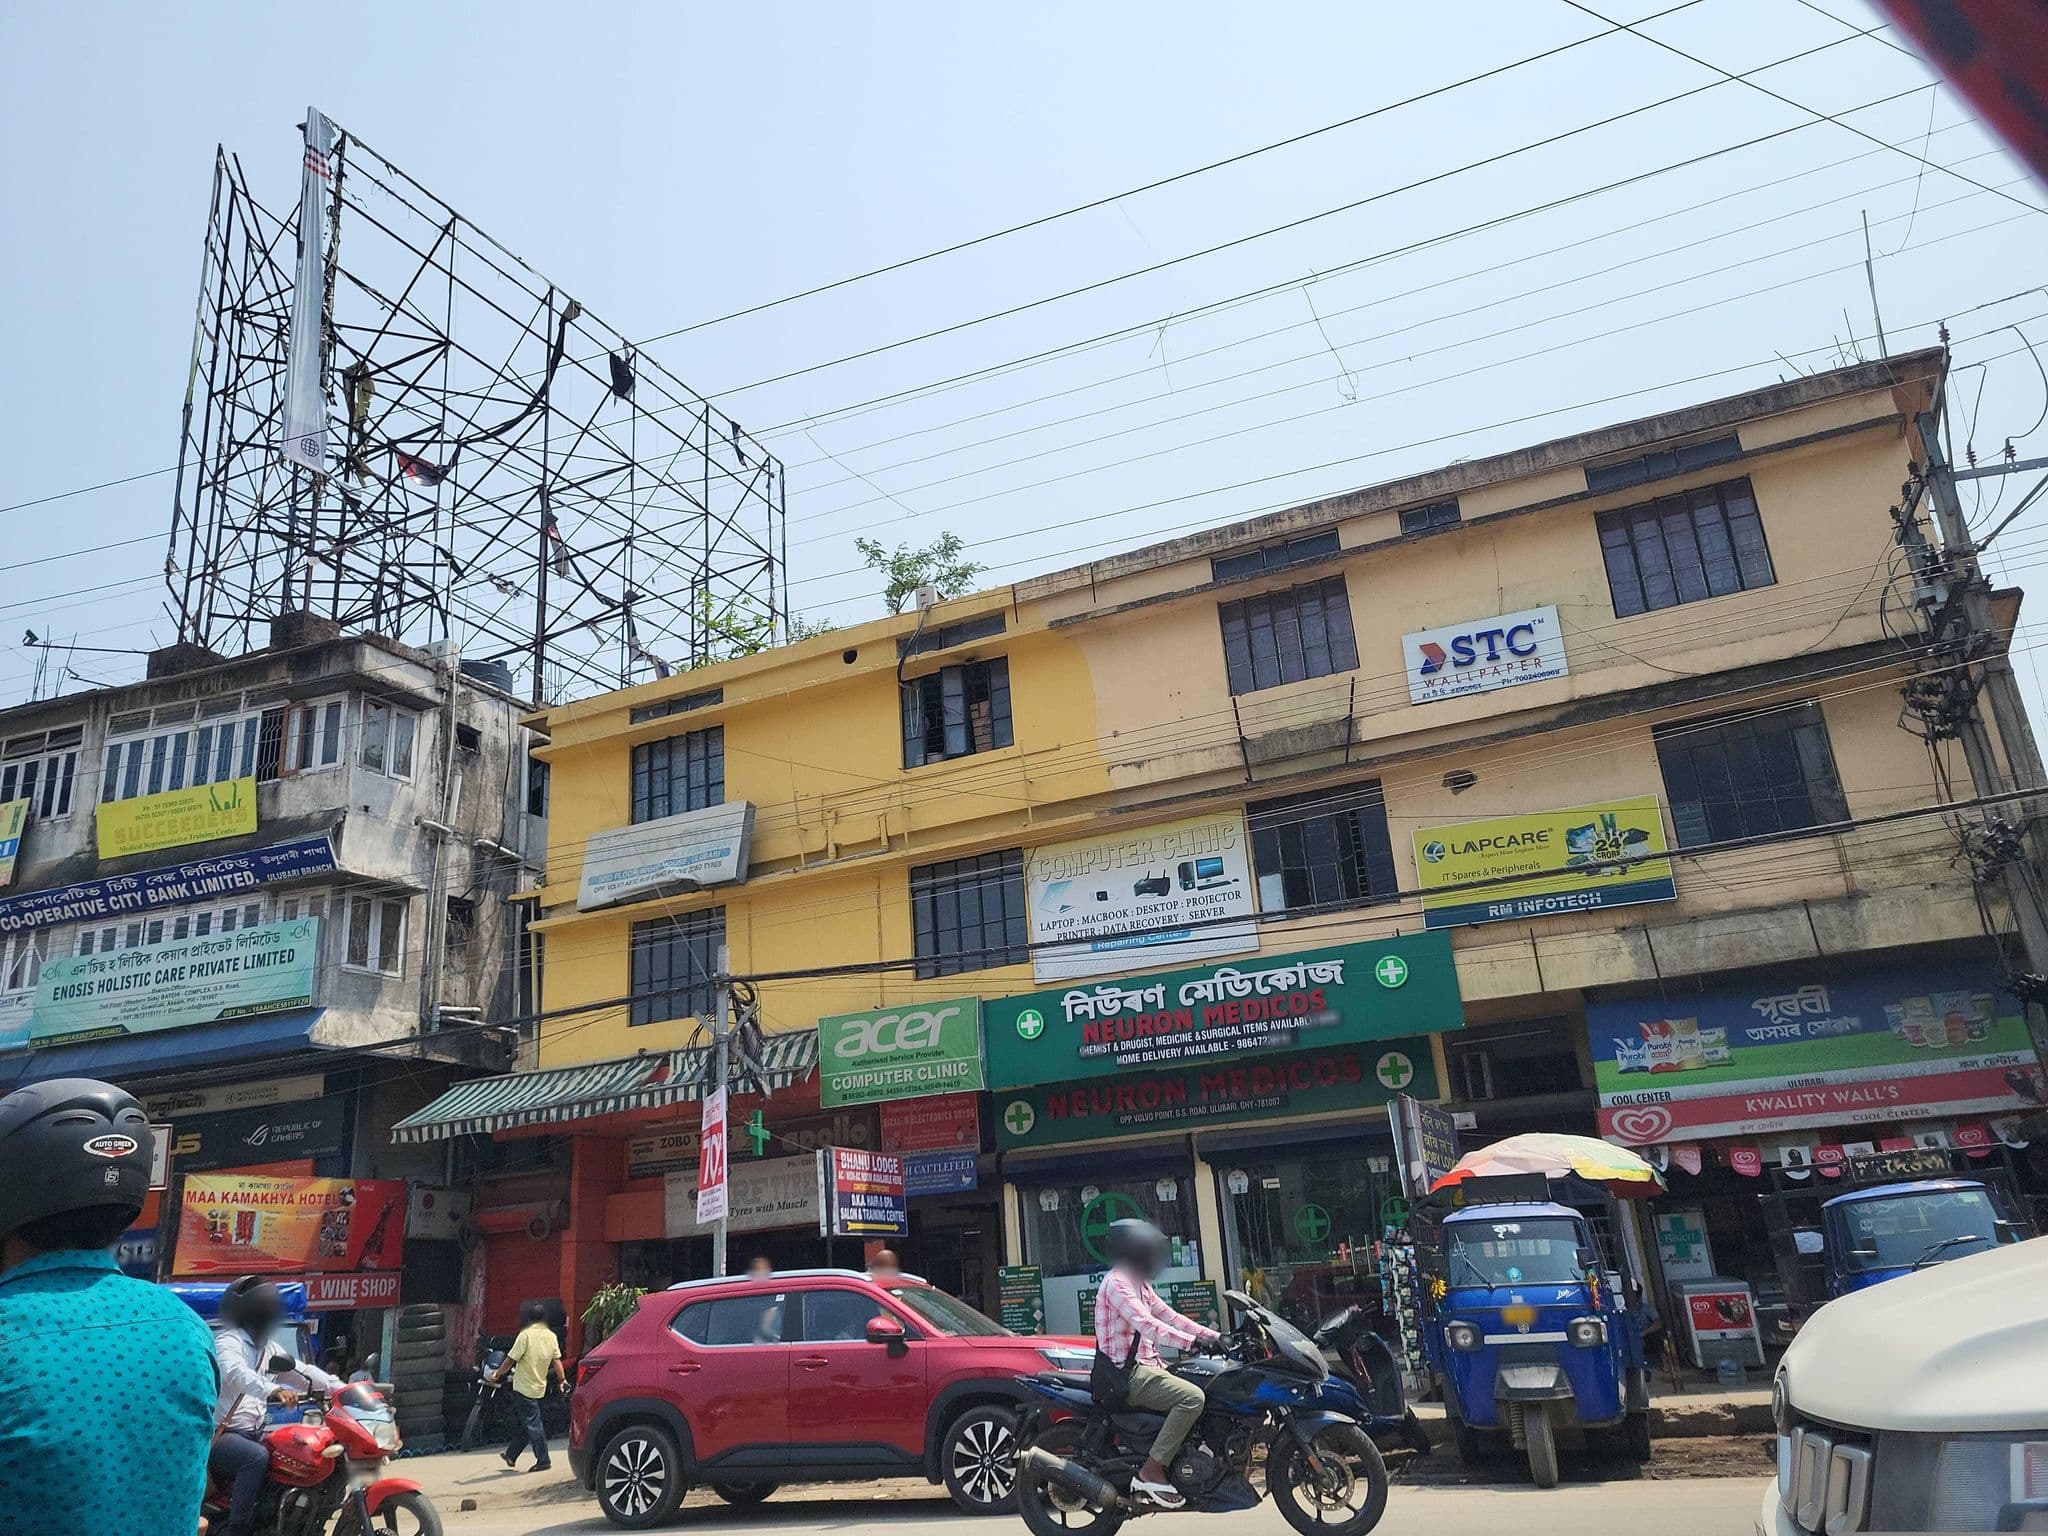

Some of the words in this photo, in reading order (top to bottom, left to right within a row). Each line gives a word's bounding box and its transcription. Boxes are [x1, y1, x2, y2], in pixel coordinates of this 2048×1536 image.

[1451, 623, 1537, 668] STC
[1424, 658, 1543, 688] WALLPAPER
[1038, 838, 1154, 883] COMPUTER
[1163, 823, 1235, 860] CLINIC
[1451, 830, 1549, 855] LAPCARE
[1594, 837, 1622, 851] 24
[703, 860, 722, 870] TYRES
[1442, 872, 1451, 881] IT
[1452, 870, 1480, 883] Spares
[1482, 867, 1489, 876] &
[1490, 861, 1541, 880] Peripherals
[0, 899, 107, 931] CO-OPERATIVE
[109, 892, 143, 910] CITY
[146, 882, 191, 904] BANK
[192, 870, 260, 896] LIMITED.
[267, 868, 301, 882] ULUBARI
[301, 863, 333, 876] BRANCH
[1488, 904, 1513, 917] RM
[1518, 891, 1602, 913] INFOTECH
[1040, 918, 1075, 931] LAPTOP
[1081, 908, 1129, 925] MACBOOK
[1136, 901, 1179, 916] DESKTOP
[1186, 891, 1242, 908] PROJECTOR
[1057, 928, 1097, 942] PRINTER
[1102, 922, 1128, 936] DATA
[1130, 914, 1179, 931] RECOVERY
[1188, 907, 1226, 920] SERVER
[52, 981, 95, 1001] ENOSIS
[97, 972, 152, 995] HOLISTIC
[154, 966, 186, 985] CARE
[189, 956, 240, 980] PRIVATE
[243, 947, 296, 971] LIMITED
[1178, 959, 1345, 1007] মেডিকোজ
[1083, 1007, 1193, 1045] NEURON
[1203, 988, 1328, 1029] MEDICOS
[834, 1006, 961, 1058] acer
[1113, 1041, 1119, 1052] &
[1155, 1031, 1193, 1046] MEDICINE
[1243, 1021, 1269, 1034] ITEMS
[889, 1053, 914, 1063] Service
[915, 1049, 945, 1060] Provider
[1117, 1055, 1141, 1066] HOME
[1142, 1047, 1182, 1062] DELIVERY
[1184, 1040, 1229, 1056] AVAILABLE
[1620, 1051, 1646, 1062] Purobi
[1646, 1041, 1672, 1052] Purobi
[832, 1068, 914, 1092] COMPUTER
[917, 1062, 969, 1081] CLINIC
[1046, 1077, 1188, 1121] NEURON
[1199, 1052, 1363, 1101] MEDICOS
[1787, 1076, 1825, 1088] ULUBARI
[1612, 1094, 1636, 1106] COOL
[1636, 1090, 1672, 1103] CENTER
[1745, 1092, 1827, 1113] KWALITY
[1833, 1085, 1900, 1104] WALL'S
[1134, 1111, 1153, 1123] VOLVO
[1852, 1111, 1885, 1122] COOL
[1887, 1107, 1933, 1119] CENTER
[270, 1131, 305, 1144] GAMERS
[271, 1122, 310, 1134] REPUBLIC
[312, 1120, 324, 1130] OF
[659, 1134, 692, 1149] ZOBO
[840, 1152, 870, 1172] BHANU
[871, 1155, 900, 1174] LODGE
[913, 1159, 974, 1175] CATTLEFEED
[186, 1190, 217, 1205] MAA
[221, 1190, 295, 1206] KAMAKHYA
[299, 1193, 340, 1206] HOTEL
[729, 1205, 753, 1217] Tyres
[754, 1203, 774, 1214] with
[776, 1198, 809, 1212] Muscle
[863, 1208, 886, 1222] TRAINING
[886, 1210, 905, 1222] CENTRE
[320, 1278, 359, 1299] WINE
[360, 1278, 396, 1297] SHOP
